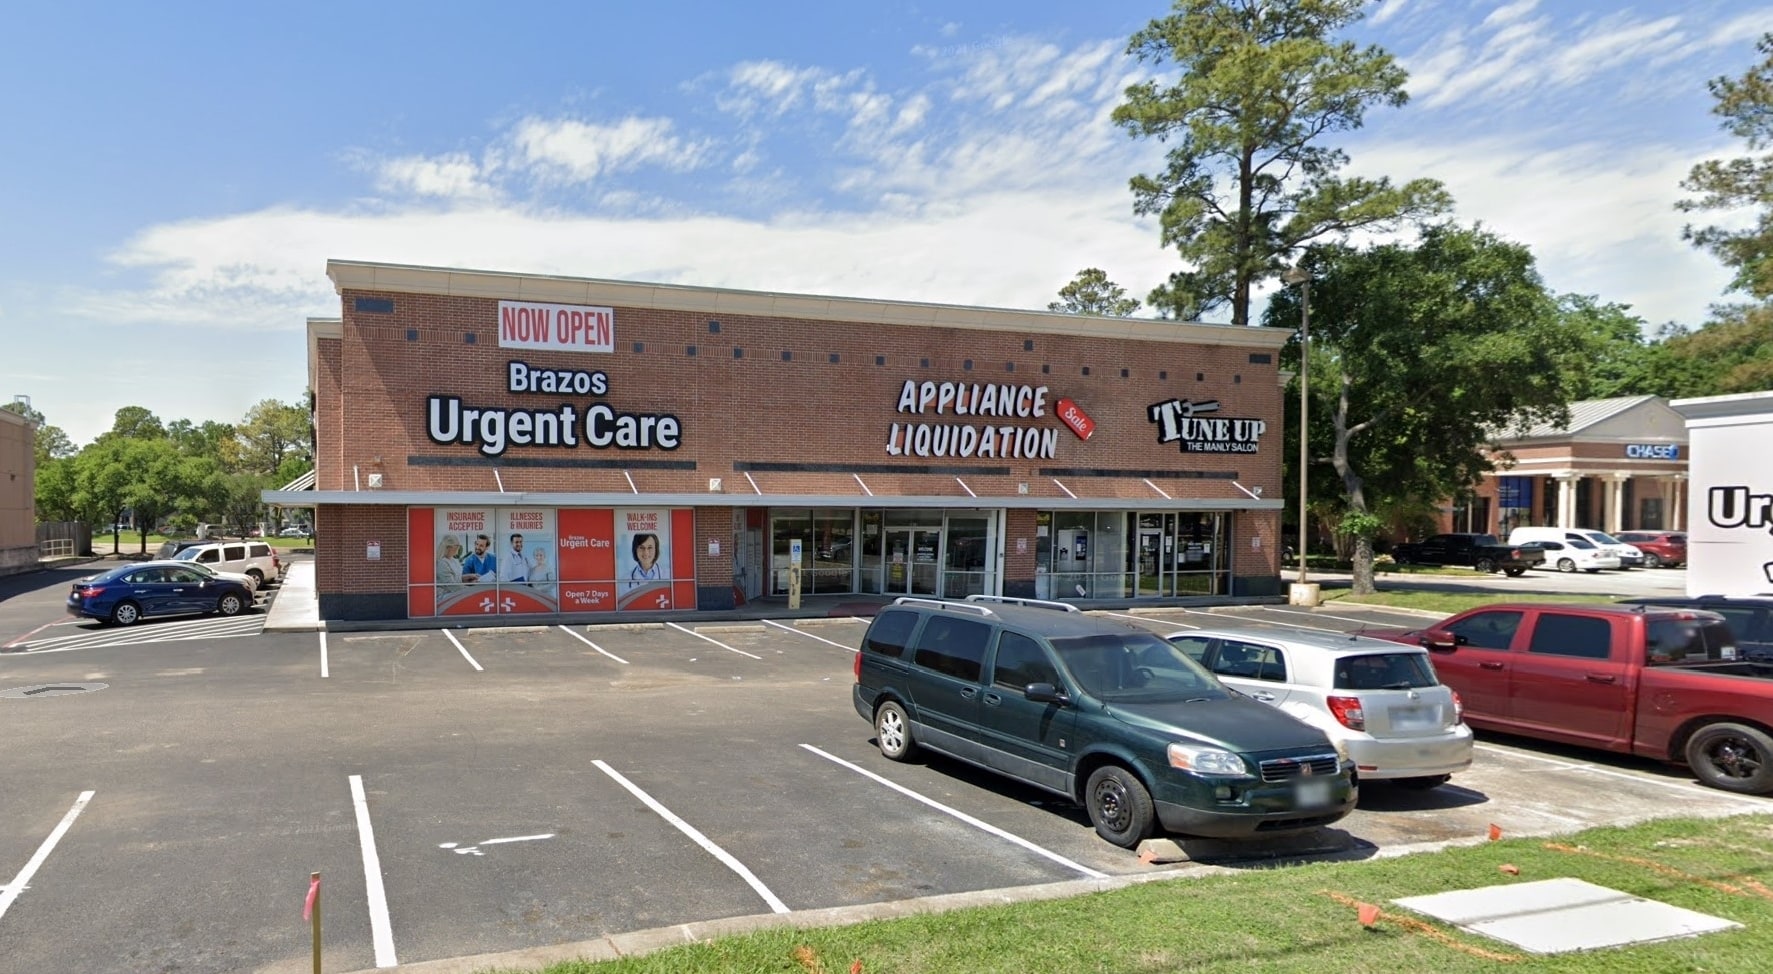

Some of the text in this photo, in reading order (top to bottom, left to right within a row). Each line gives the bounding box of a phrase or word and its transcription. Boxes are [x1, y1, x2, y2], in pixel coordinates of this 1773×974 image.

[502, 306, 610, 346] NOW OPEN
[509, 362, 608, 395] Brazos
[896, 379, 1049, 418] APPLIANCE
[1063, 406, 1088, 433] Sale
[1152, 400, 1267, 442] TUNE UP
[428, 398, 680, 455] Urgent Care
[888, 422, 1059, 460] LIQUIDATION
[1186, 442, 1259, 452] THE MANLY SALON
[1626, 444, 1672, 459] CHASE
[446, 511, 486, 521] INSURANCE
[510, 512, 543, 521] ILLNESSES
[627, 512, 658, 521] WALK-INS
[1708, 486, 1773, 536] Ur
[448, 521, 484, 531] ACCEPTED
[510, 521, 543, 530] & INJURIES
[627, 522, 658, 531] WELCOME
[560, 538, 610, 549] Urgent Care
[565, 590, 585, 598] Open
[592, 590, 609, 598] Days
